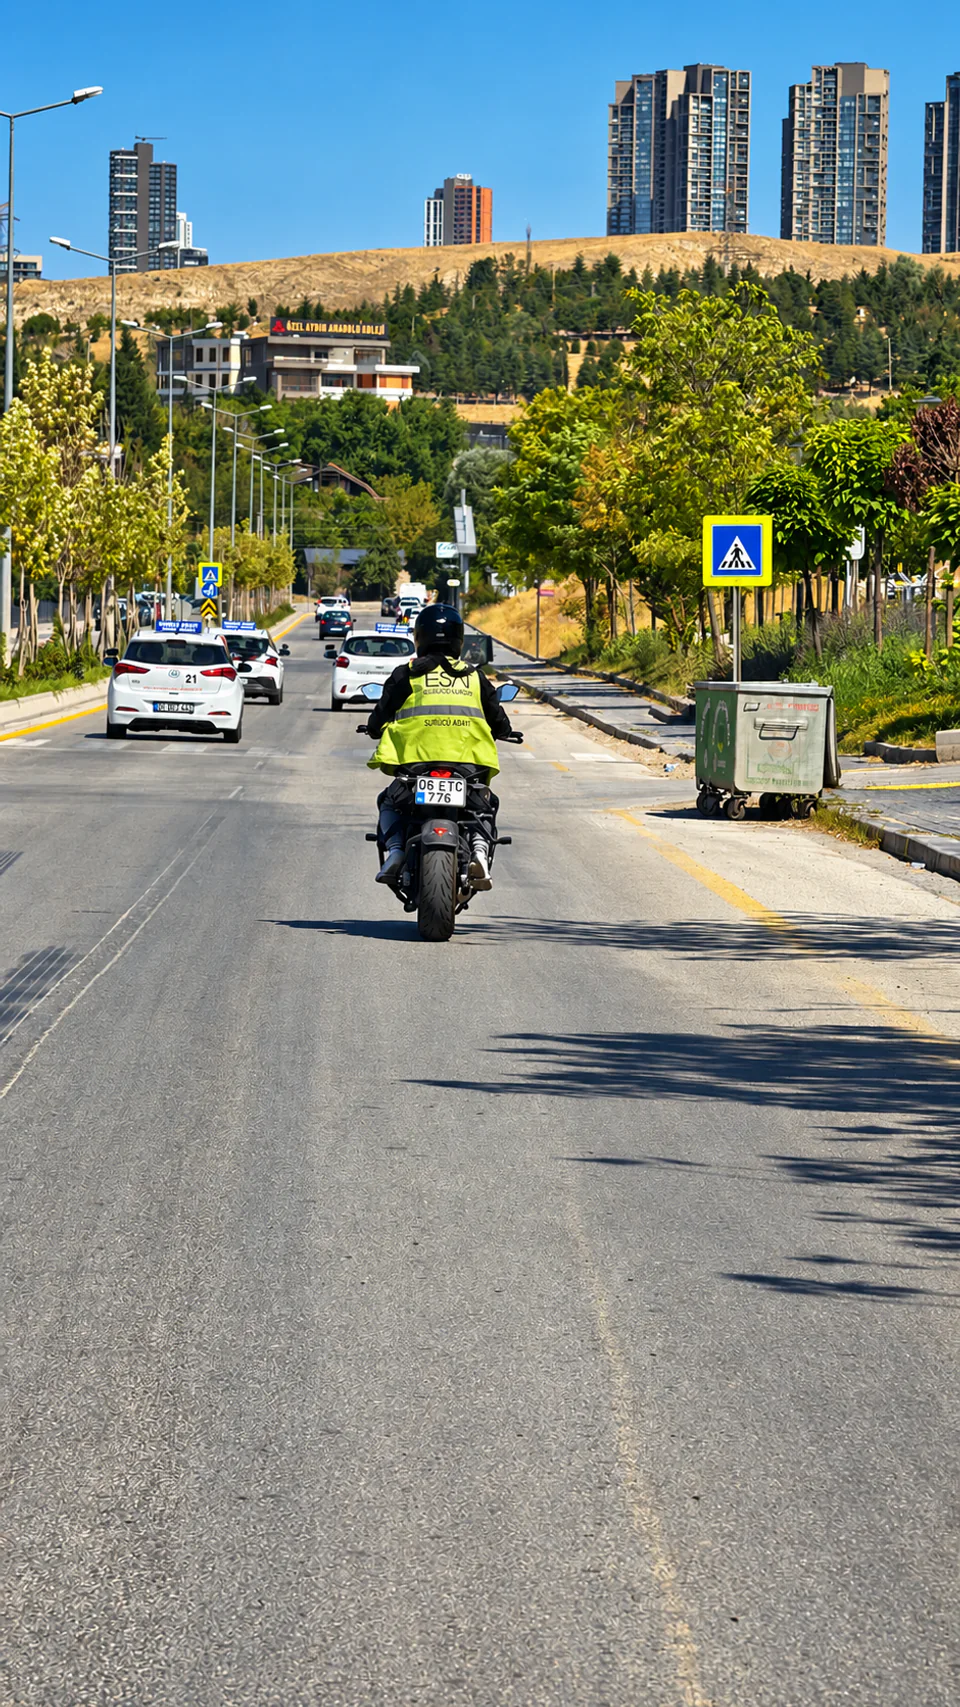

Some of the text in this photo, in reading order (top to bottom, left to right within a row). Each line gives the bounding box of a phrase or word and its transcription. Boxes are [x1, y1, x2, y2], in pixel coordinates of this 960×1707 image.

[286, 320, 304, 331] ÖZEL
[328, 323, 360, 334] ANADOLU
[185, 674, 197, 684] 21
[419, 779, 462, 792] 06 ETC
[428, 792, 451, 803] 776
